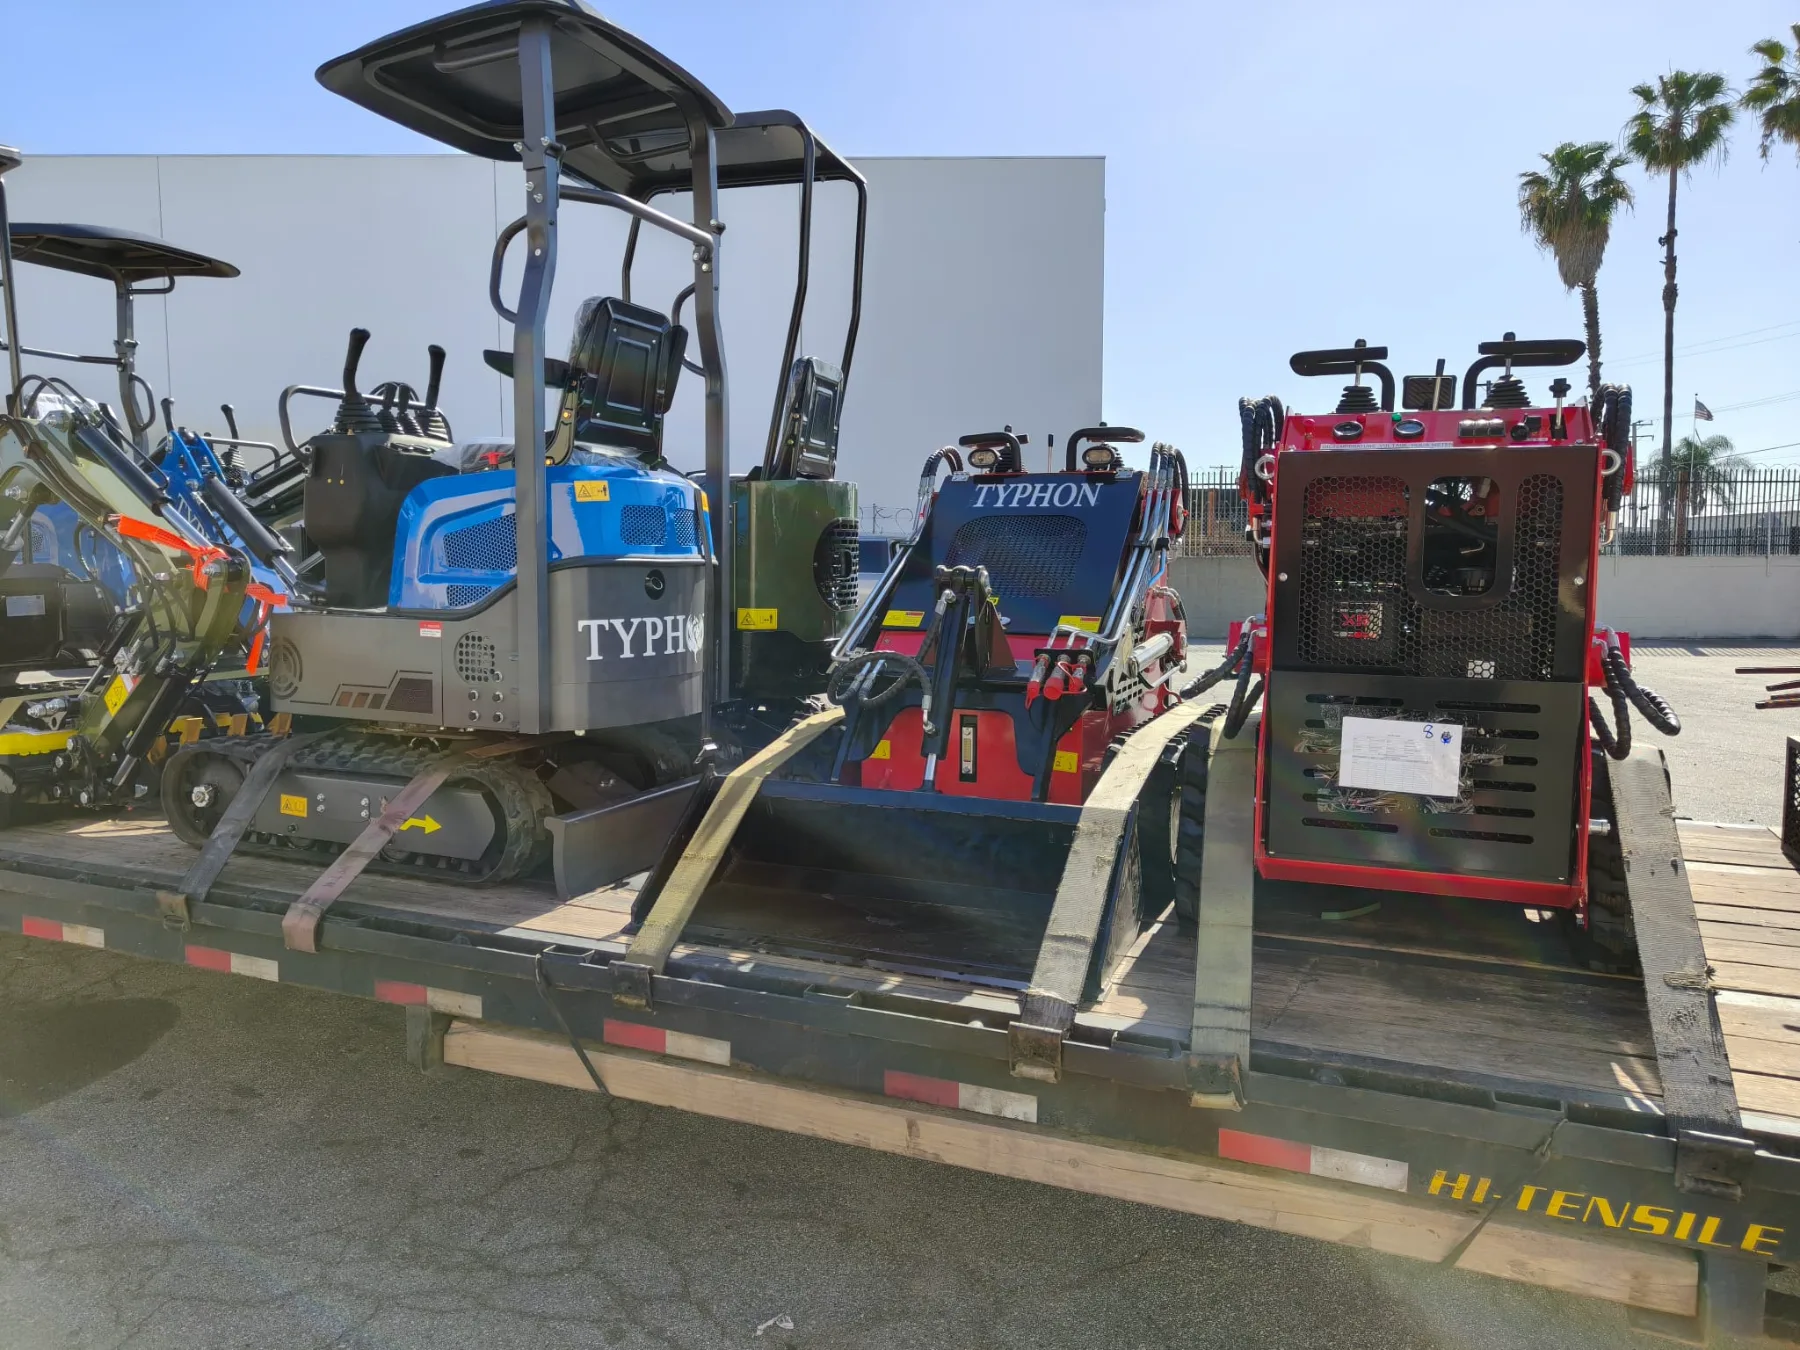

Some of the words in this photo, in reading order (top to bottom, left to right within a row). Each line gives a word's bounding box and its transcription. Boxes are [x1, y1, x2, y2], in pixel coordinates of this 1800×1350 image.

[973, 482, 1104, 508] TYPHON
[577, 613, 704, 662] TYPHO
[1422, 724, 1435, 739] 8
